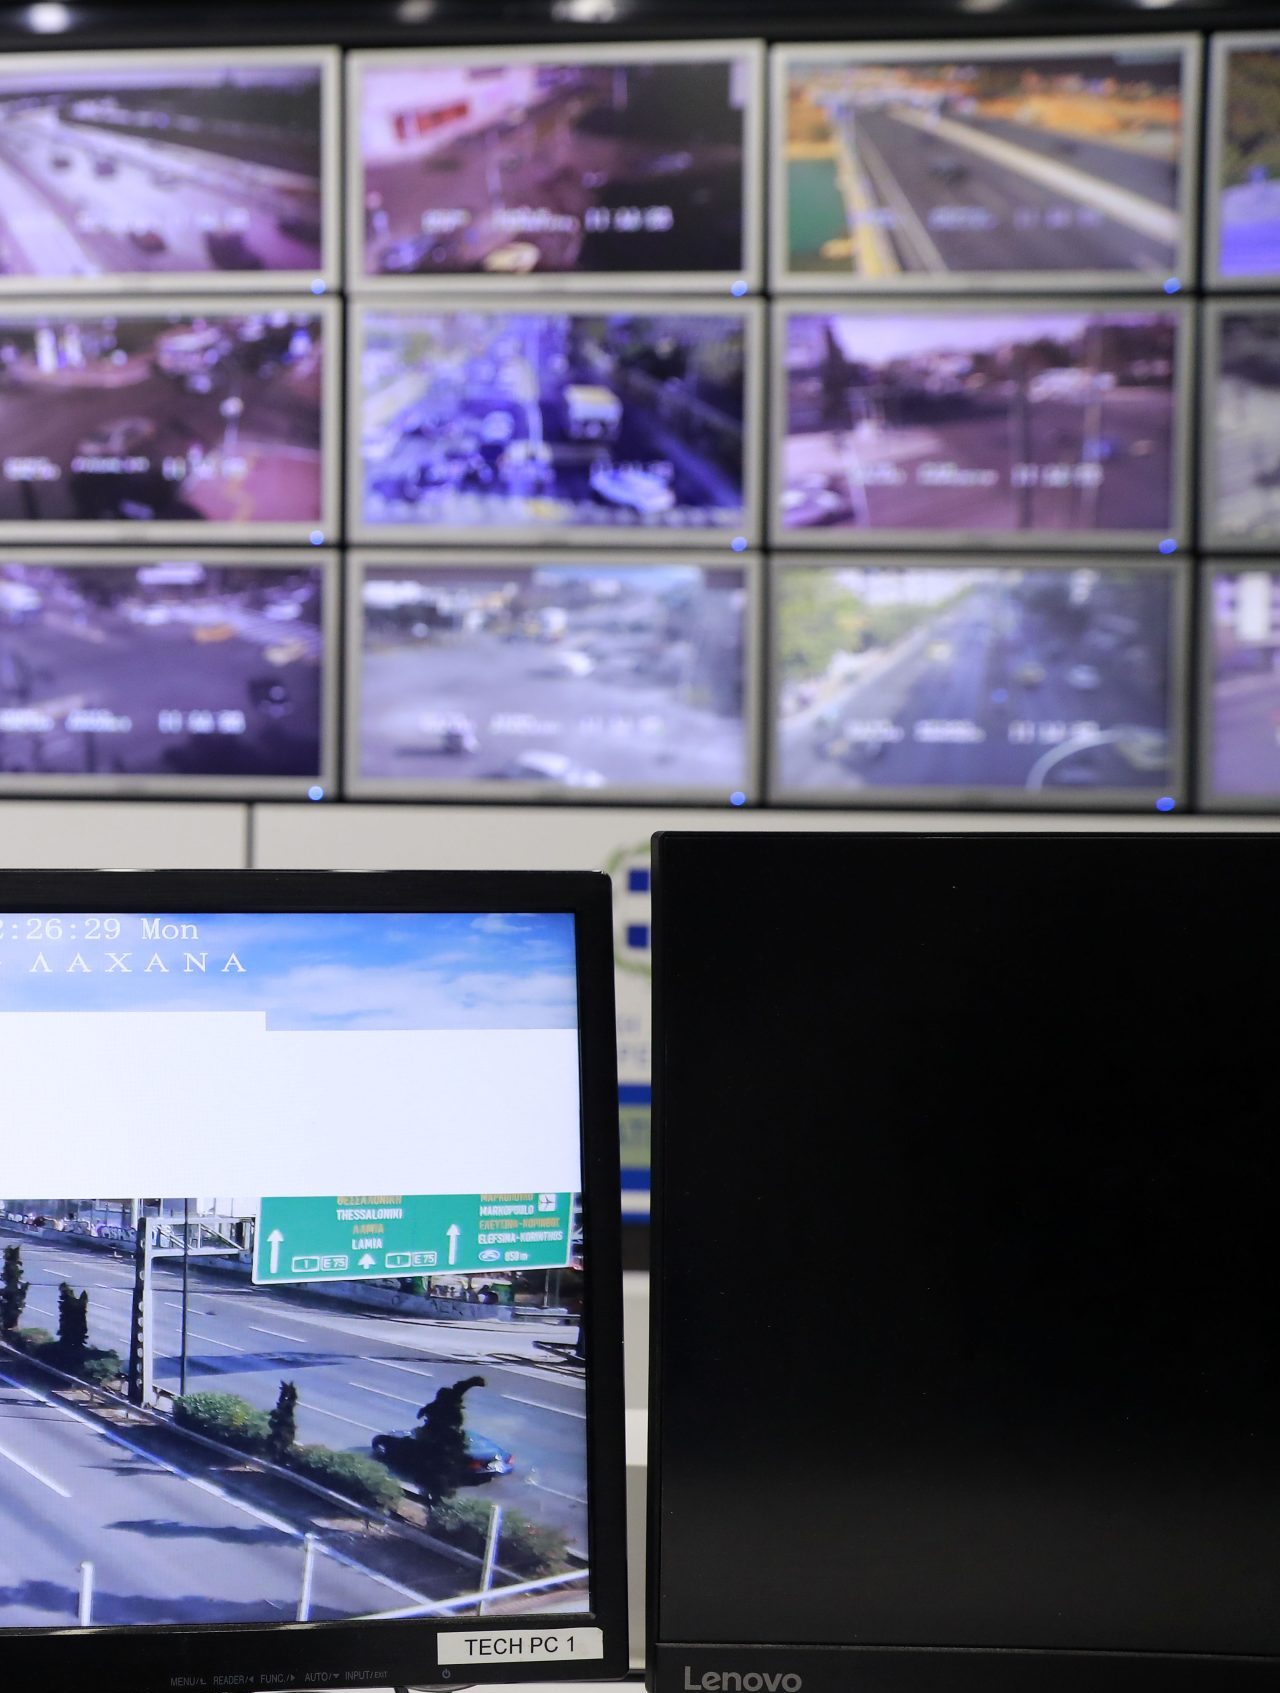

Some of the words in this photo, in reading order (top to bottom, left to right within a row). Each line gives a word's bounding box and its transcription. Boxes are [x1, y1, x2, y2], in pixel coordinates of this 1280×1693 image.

[141, 918, 199, 940] Mon
[29, 951, 247, 973] ΛΑΧΑΝΑ
[336, 1208, 403, 1221] THESSALONIKI
[351, 1238, 383, 1250] LAMIA
[464, 1637, 522, 1656] TECH
[530, 1636, 559, 1654] PC
[566, 1635, 574, 1652] 1
[684, 1665, 802, 1693] Lenovo
